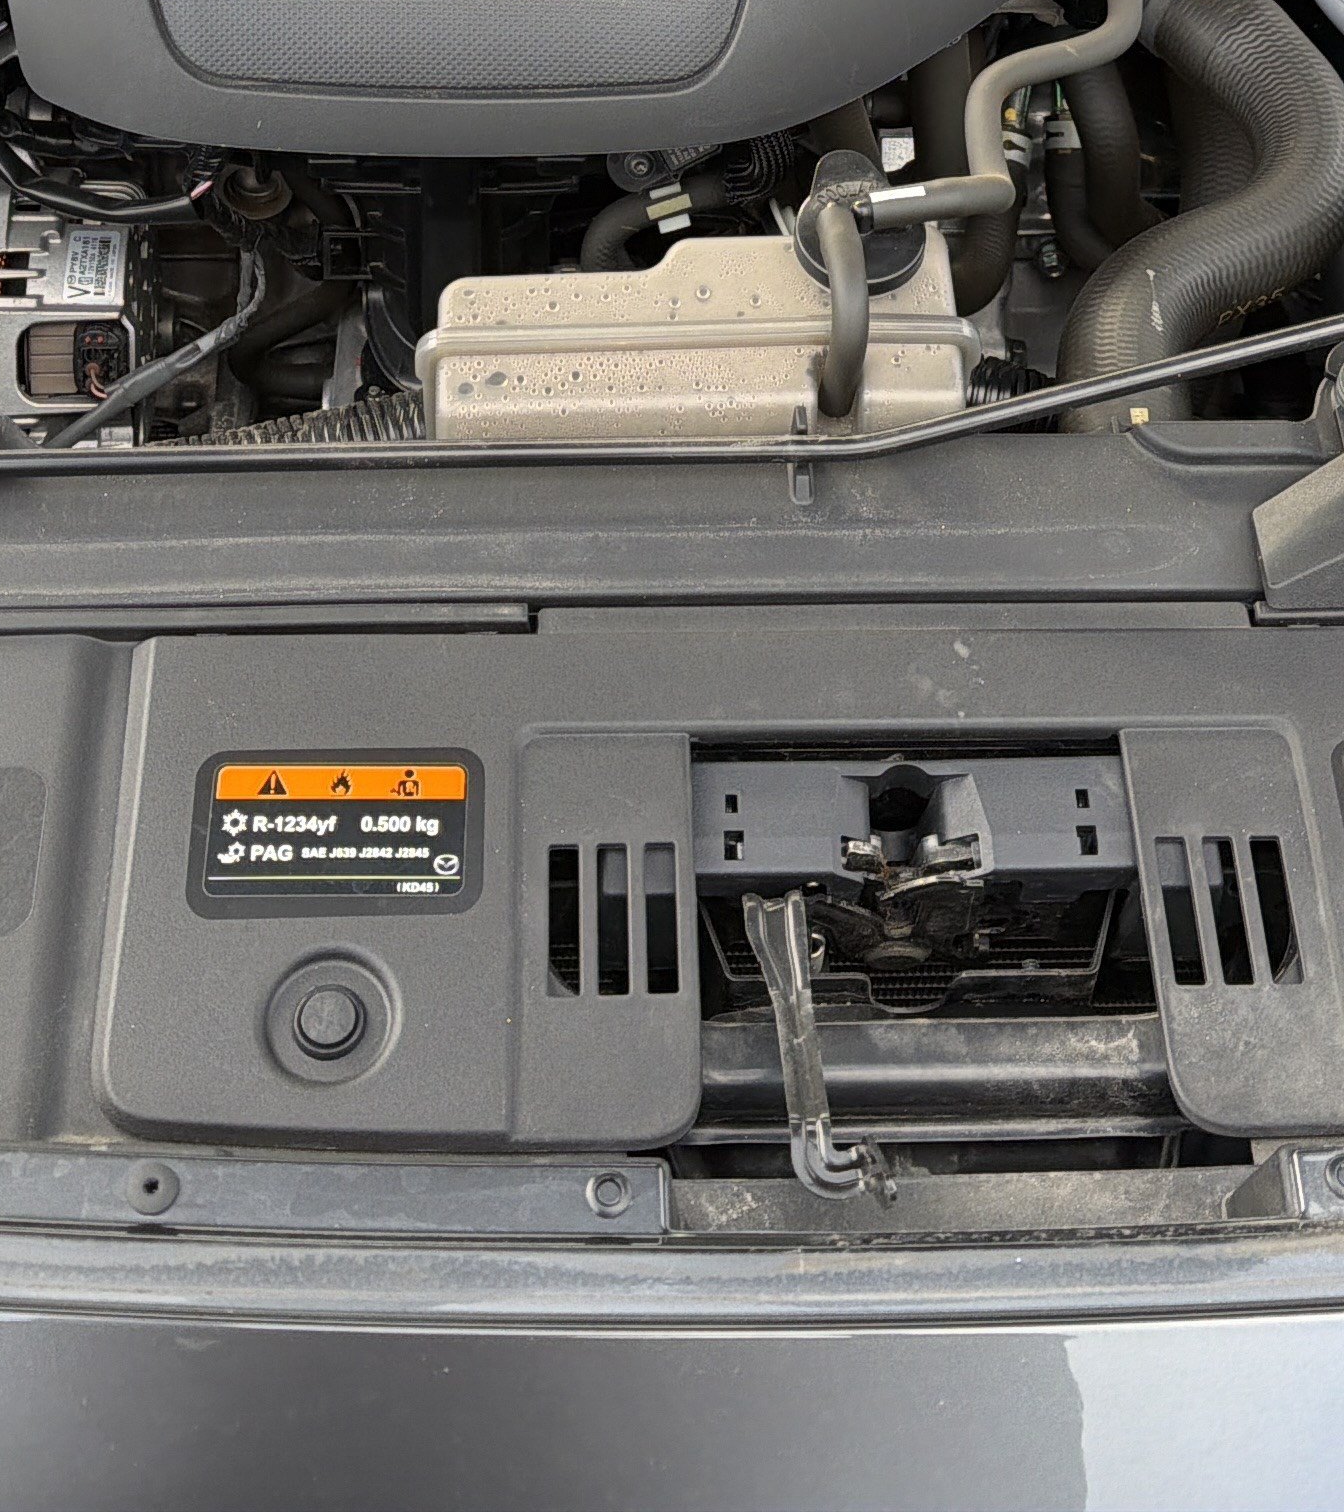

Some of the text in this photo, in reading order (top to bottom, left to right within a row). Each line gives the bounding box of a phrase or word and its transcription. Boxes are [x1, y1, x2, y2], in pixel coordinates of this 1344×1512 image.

[361, 816, 411, 833] 0.500
[415, 816, 440, 835] kg
[251, 844, 293, 861] PAG
[301, 846, 327, 859] SAE
